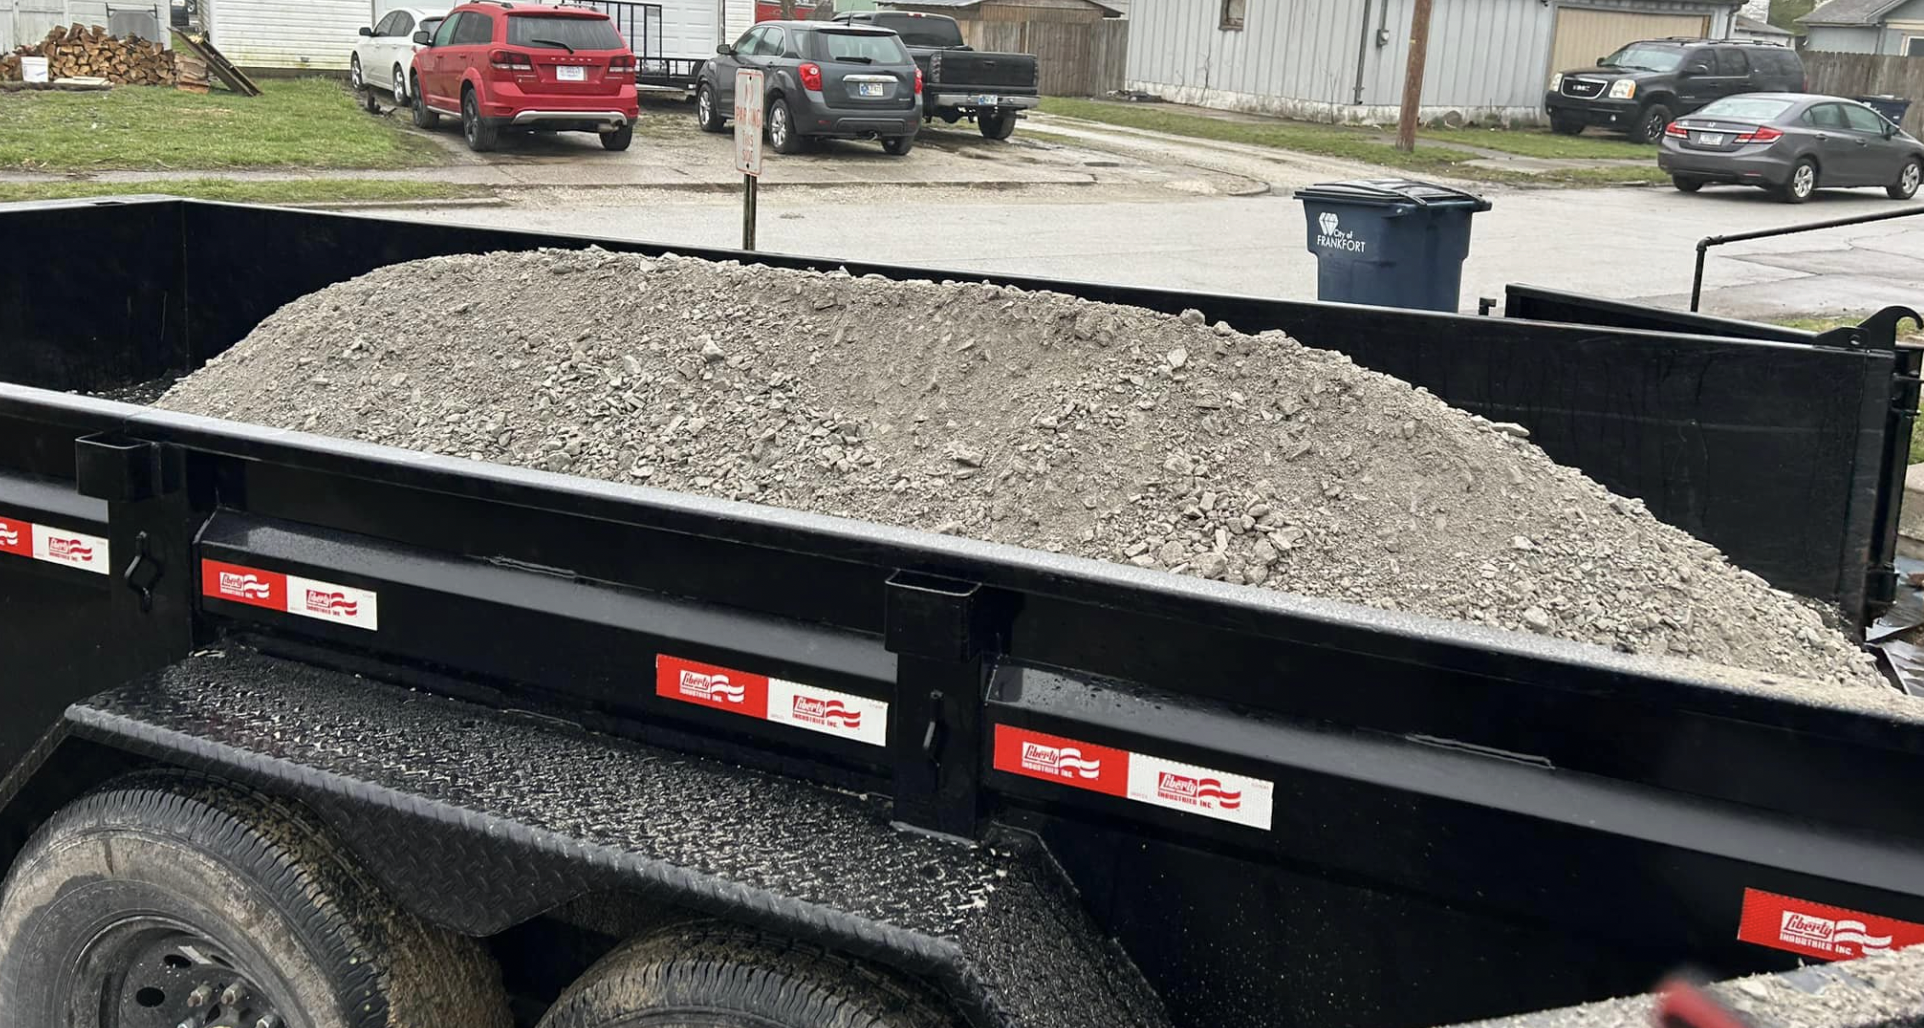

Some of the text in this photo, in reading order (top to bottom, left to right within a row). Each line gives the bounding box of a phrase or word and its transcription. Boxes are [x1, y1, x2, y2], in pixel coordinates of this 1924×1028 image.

[1317, 234, 1366, 253] FRANKFORT
[681, 672, 710, 690] Liberty
[794, 696, 825, 718] Liberty
[1024, 744, 1060, 765] Liberty
[1159, 773, 1197, 797] Liberty
[1783, 914, 1833, 939] Liberty
[1835, 944, 1854, 956] INC.
